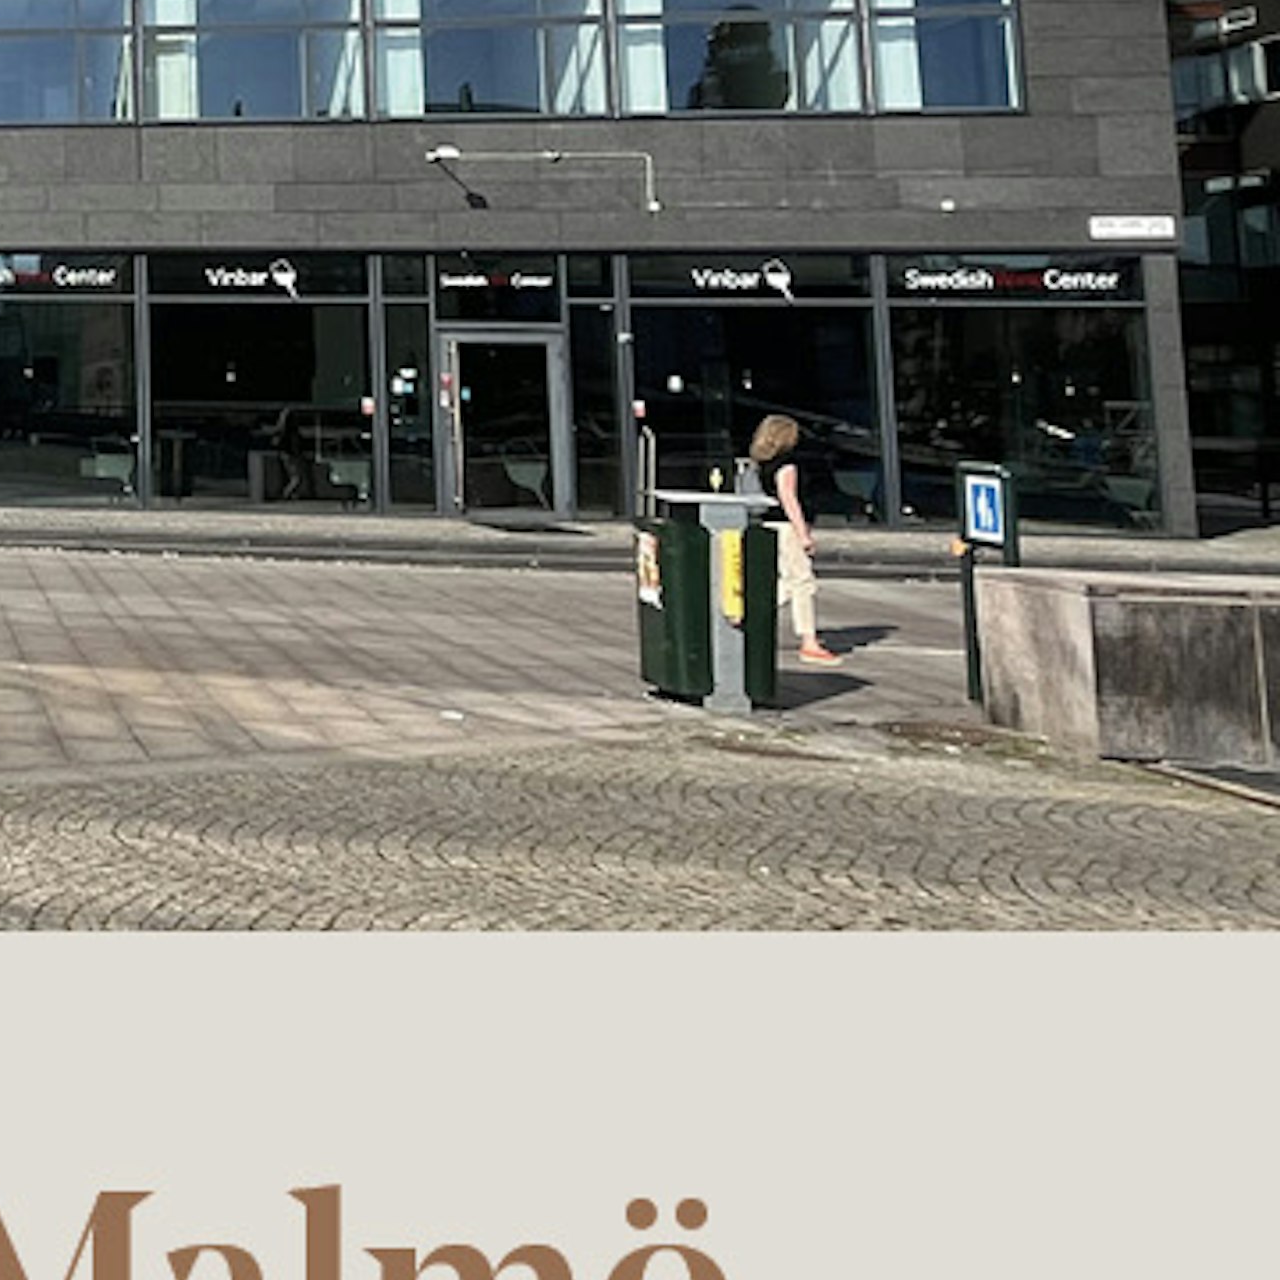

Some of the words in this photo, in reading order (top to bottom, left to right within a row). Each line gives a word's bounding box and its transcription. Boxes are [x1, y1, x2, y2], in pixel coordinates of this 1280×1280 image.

[52, 264, 117, 286] Center
[205, 267, 269, 287] Vinbar
[690, 268, 761, 289] Vinbar
[904, 267, 995, 290] Swedish
[1042, 268, 1120, 290] Center
